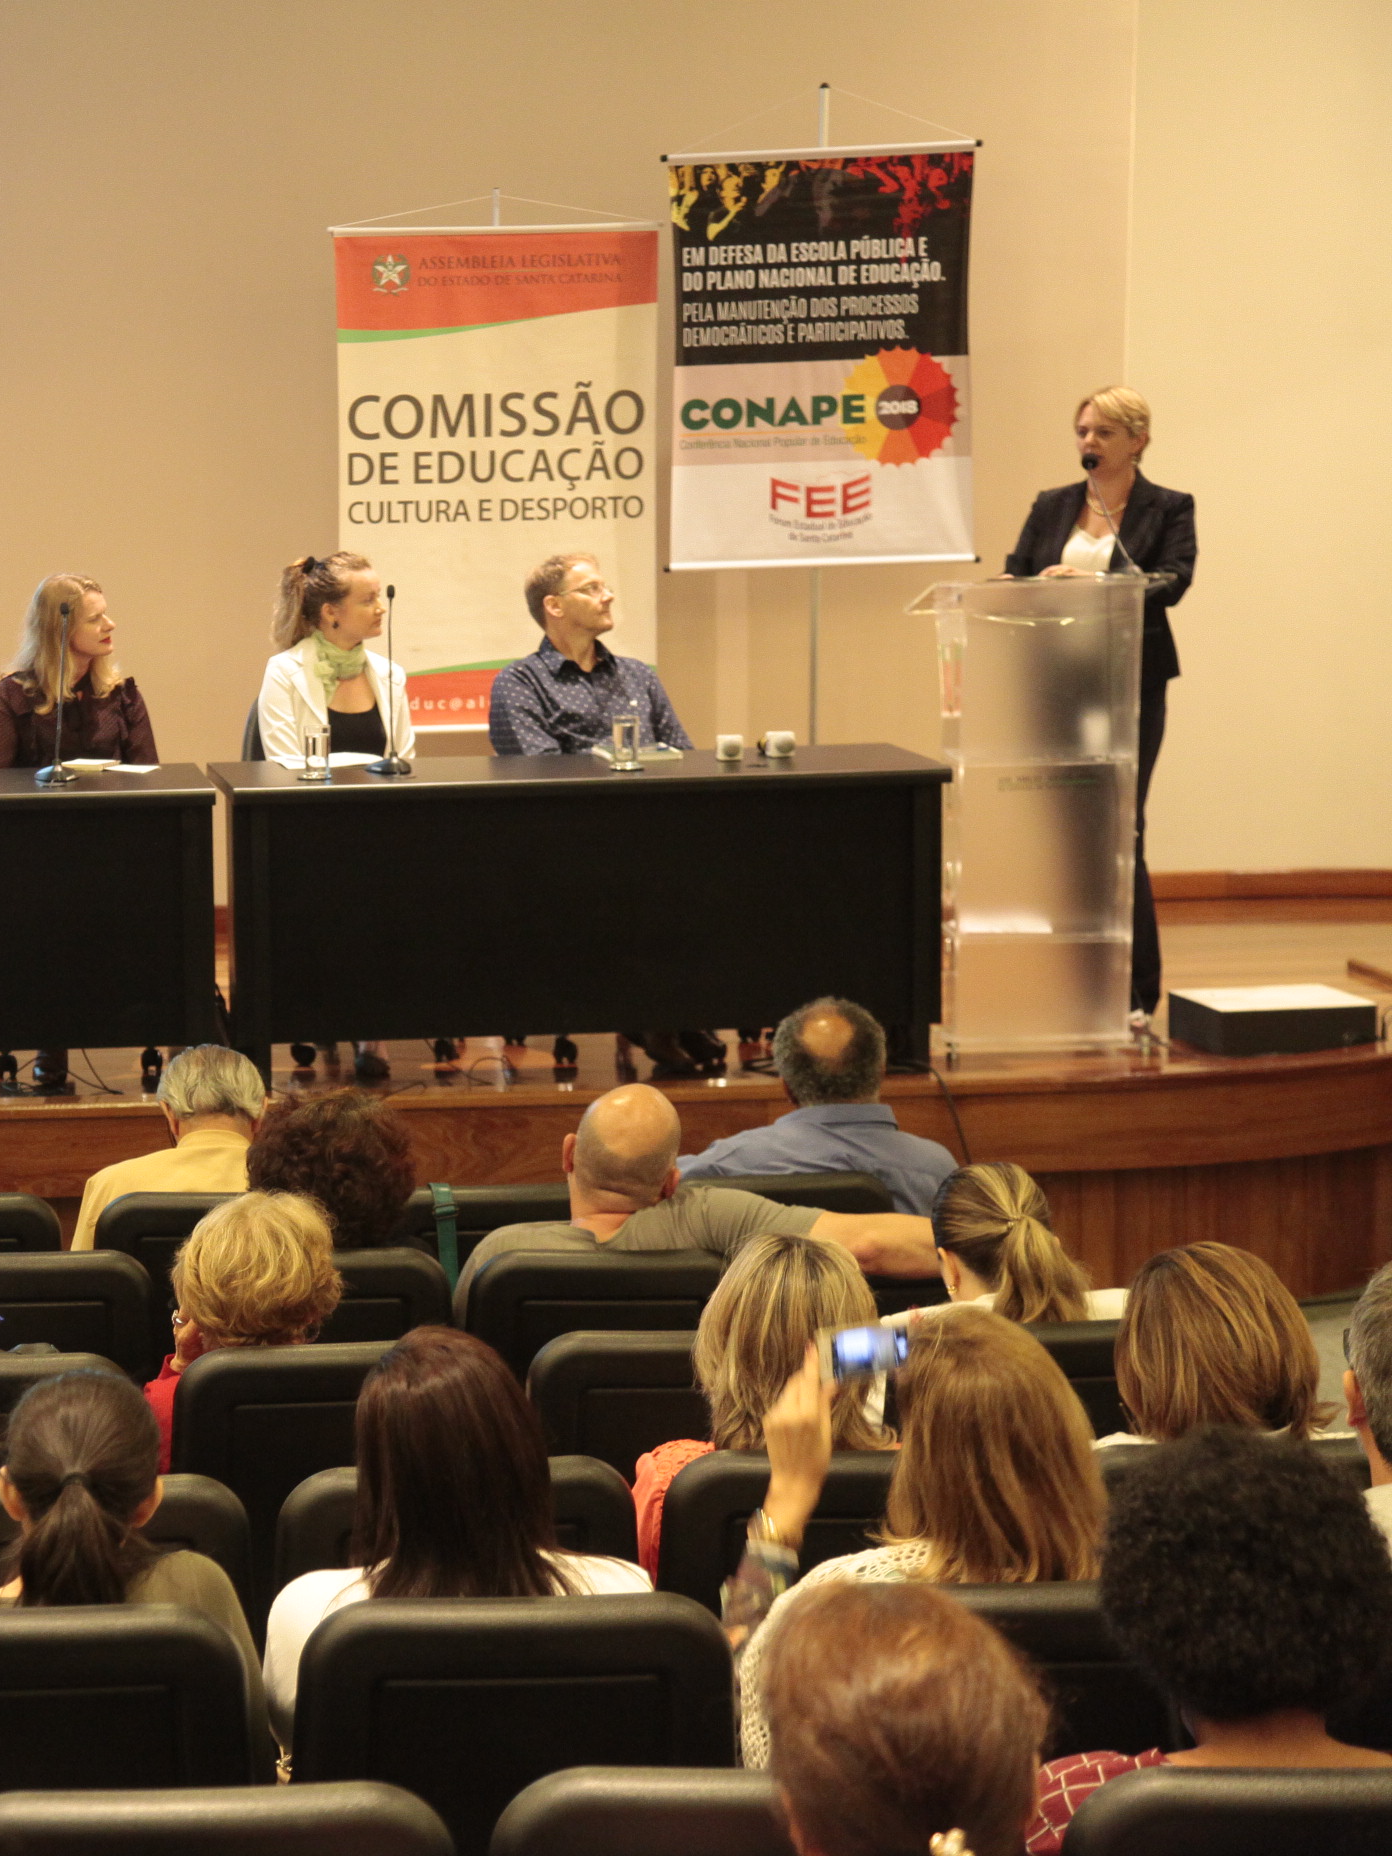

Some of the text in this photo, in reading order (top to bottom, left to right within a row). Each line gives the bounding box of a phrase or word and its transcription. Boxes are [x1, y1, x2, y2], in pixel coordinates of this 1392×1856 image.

[418, 252, 622, 270] ASSEMBLEIA LEGISLATIVA
[682, 235, 928, 267] EM DEFESA DA ESCOLA PÚBLICA E
[418, 272, 622, 287] DO ESTADO DE SANTA CATARINA
[682, 260, 946, 292] DO PLANO NACIONAL DE EDUCAÇÃO.
[682, 293, 919, 324] PELA MANUTENÇÃO DOS PROCESSOS
[682, 319, 910, 347] DEMOCRÁTICOS E PARTICIPATIVOS.
[348, 380, 645, 441] COMISSÃO
[680, 394, 920, 431] CONAPE 2018
[348, 440, 644, 491] DE EDUCAÇÃO
[348, 495, 644, 524] CULTURA E DESPORTO
[769, 473, 872, 519] FEE
